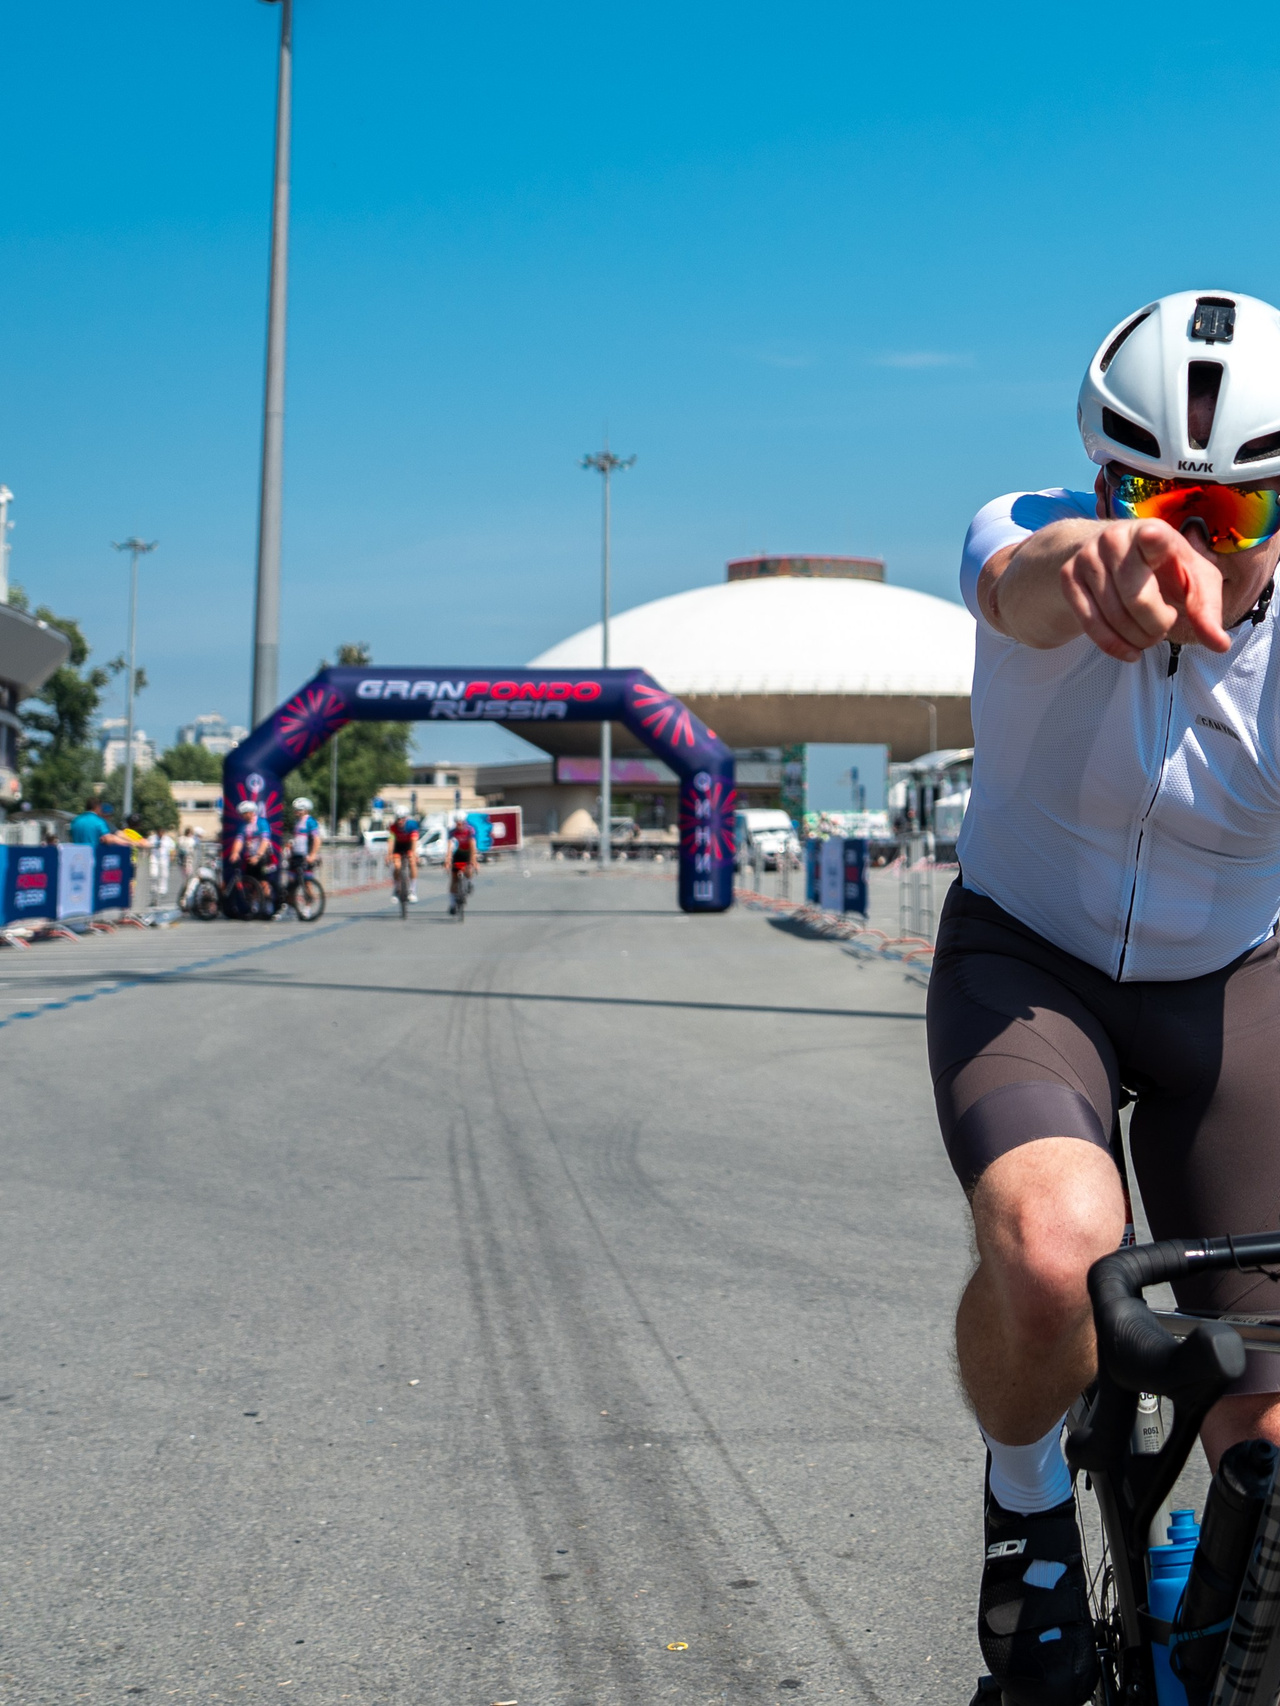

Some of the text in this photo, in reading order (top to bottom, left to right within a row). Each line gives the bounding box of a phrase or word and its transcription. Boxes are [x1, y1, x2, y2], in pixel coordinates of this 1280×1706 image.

[1178, 460, 1213, 473] KASK
[430, 700, 568, 719] RUSSIA
[1201, 717, 1242, 743] CANYO
[986, 1538, 1027, 1560] SIDI
